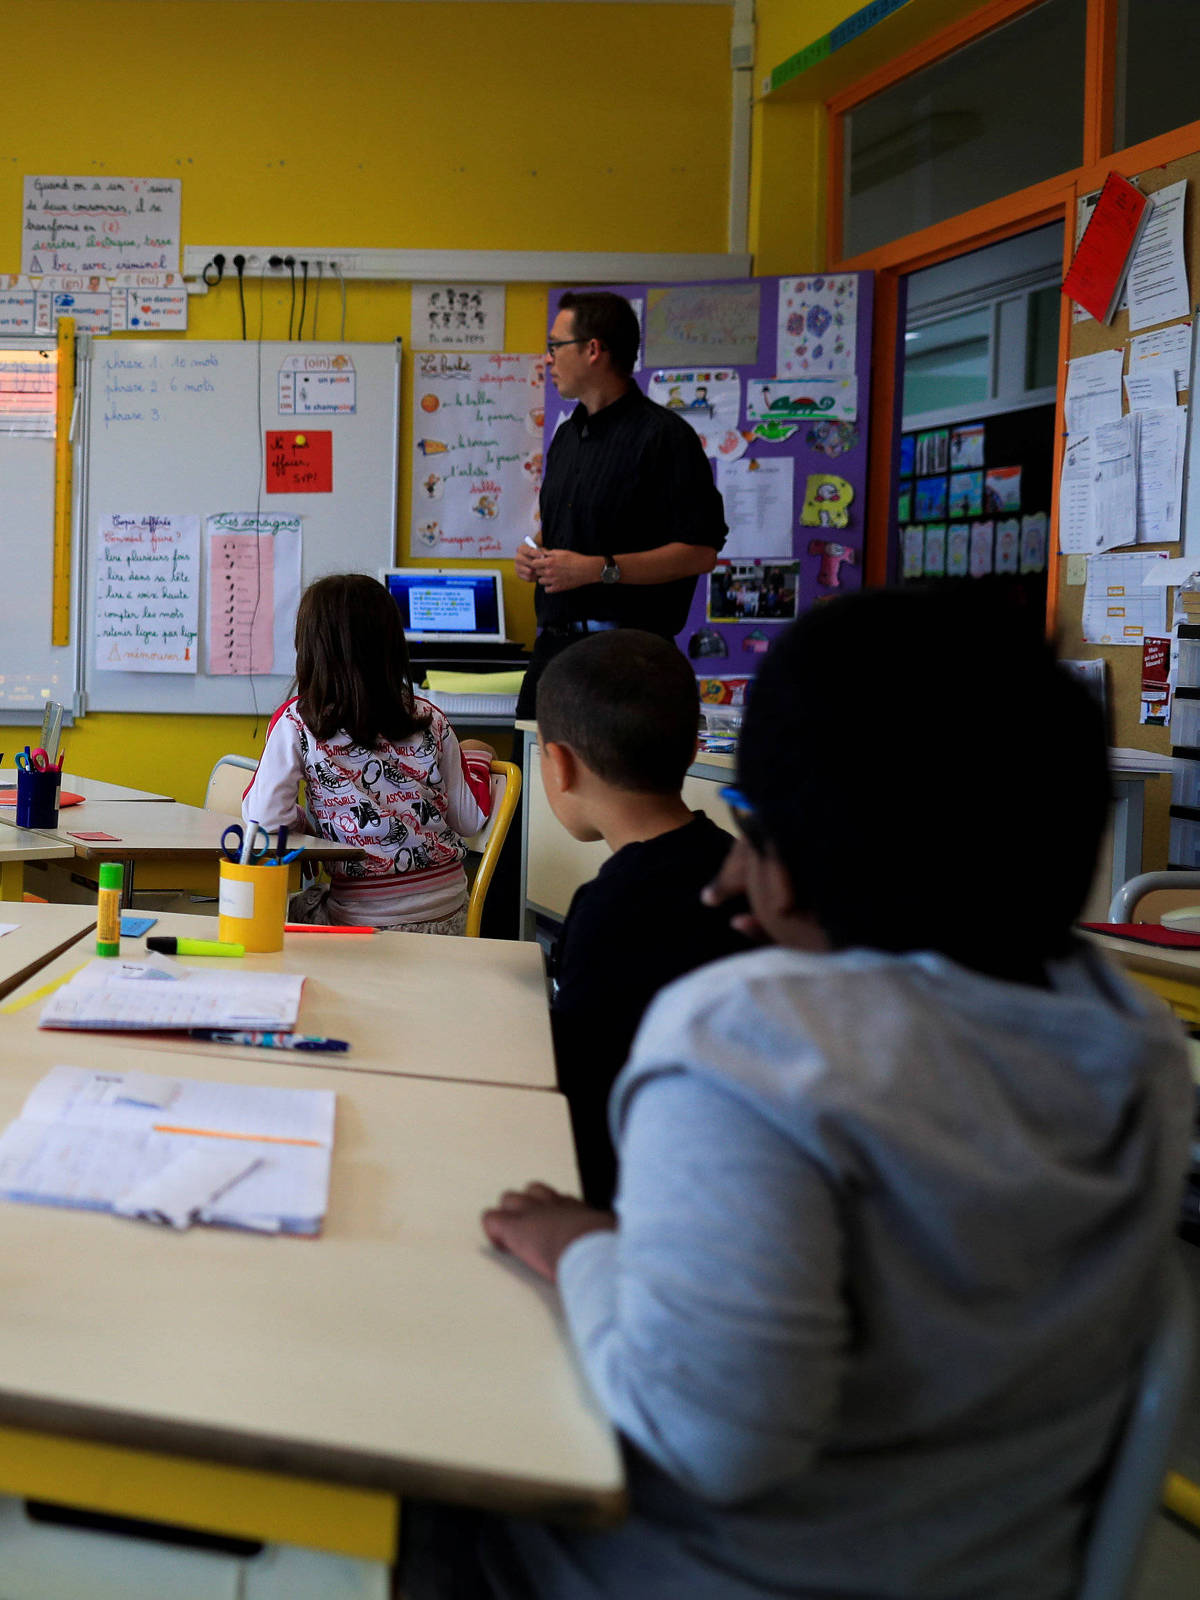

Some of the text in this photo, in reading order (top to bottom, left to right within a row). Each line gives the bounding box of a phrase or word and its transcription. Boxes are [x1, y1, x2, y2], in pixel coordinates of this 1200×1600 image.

[34, 178, 70, 198] Quand
[103, 351, 143, 378] phrase
[190, 353, 219, 367] mots
[104, 376, 144, 401] phrase
[184, 377, 215, 392] mots
[104, 402, 144, 431] phrase
[241, 517, 300, 536] consignes
